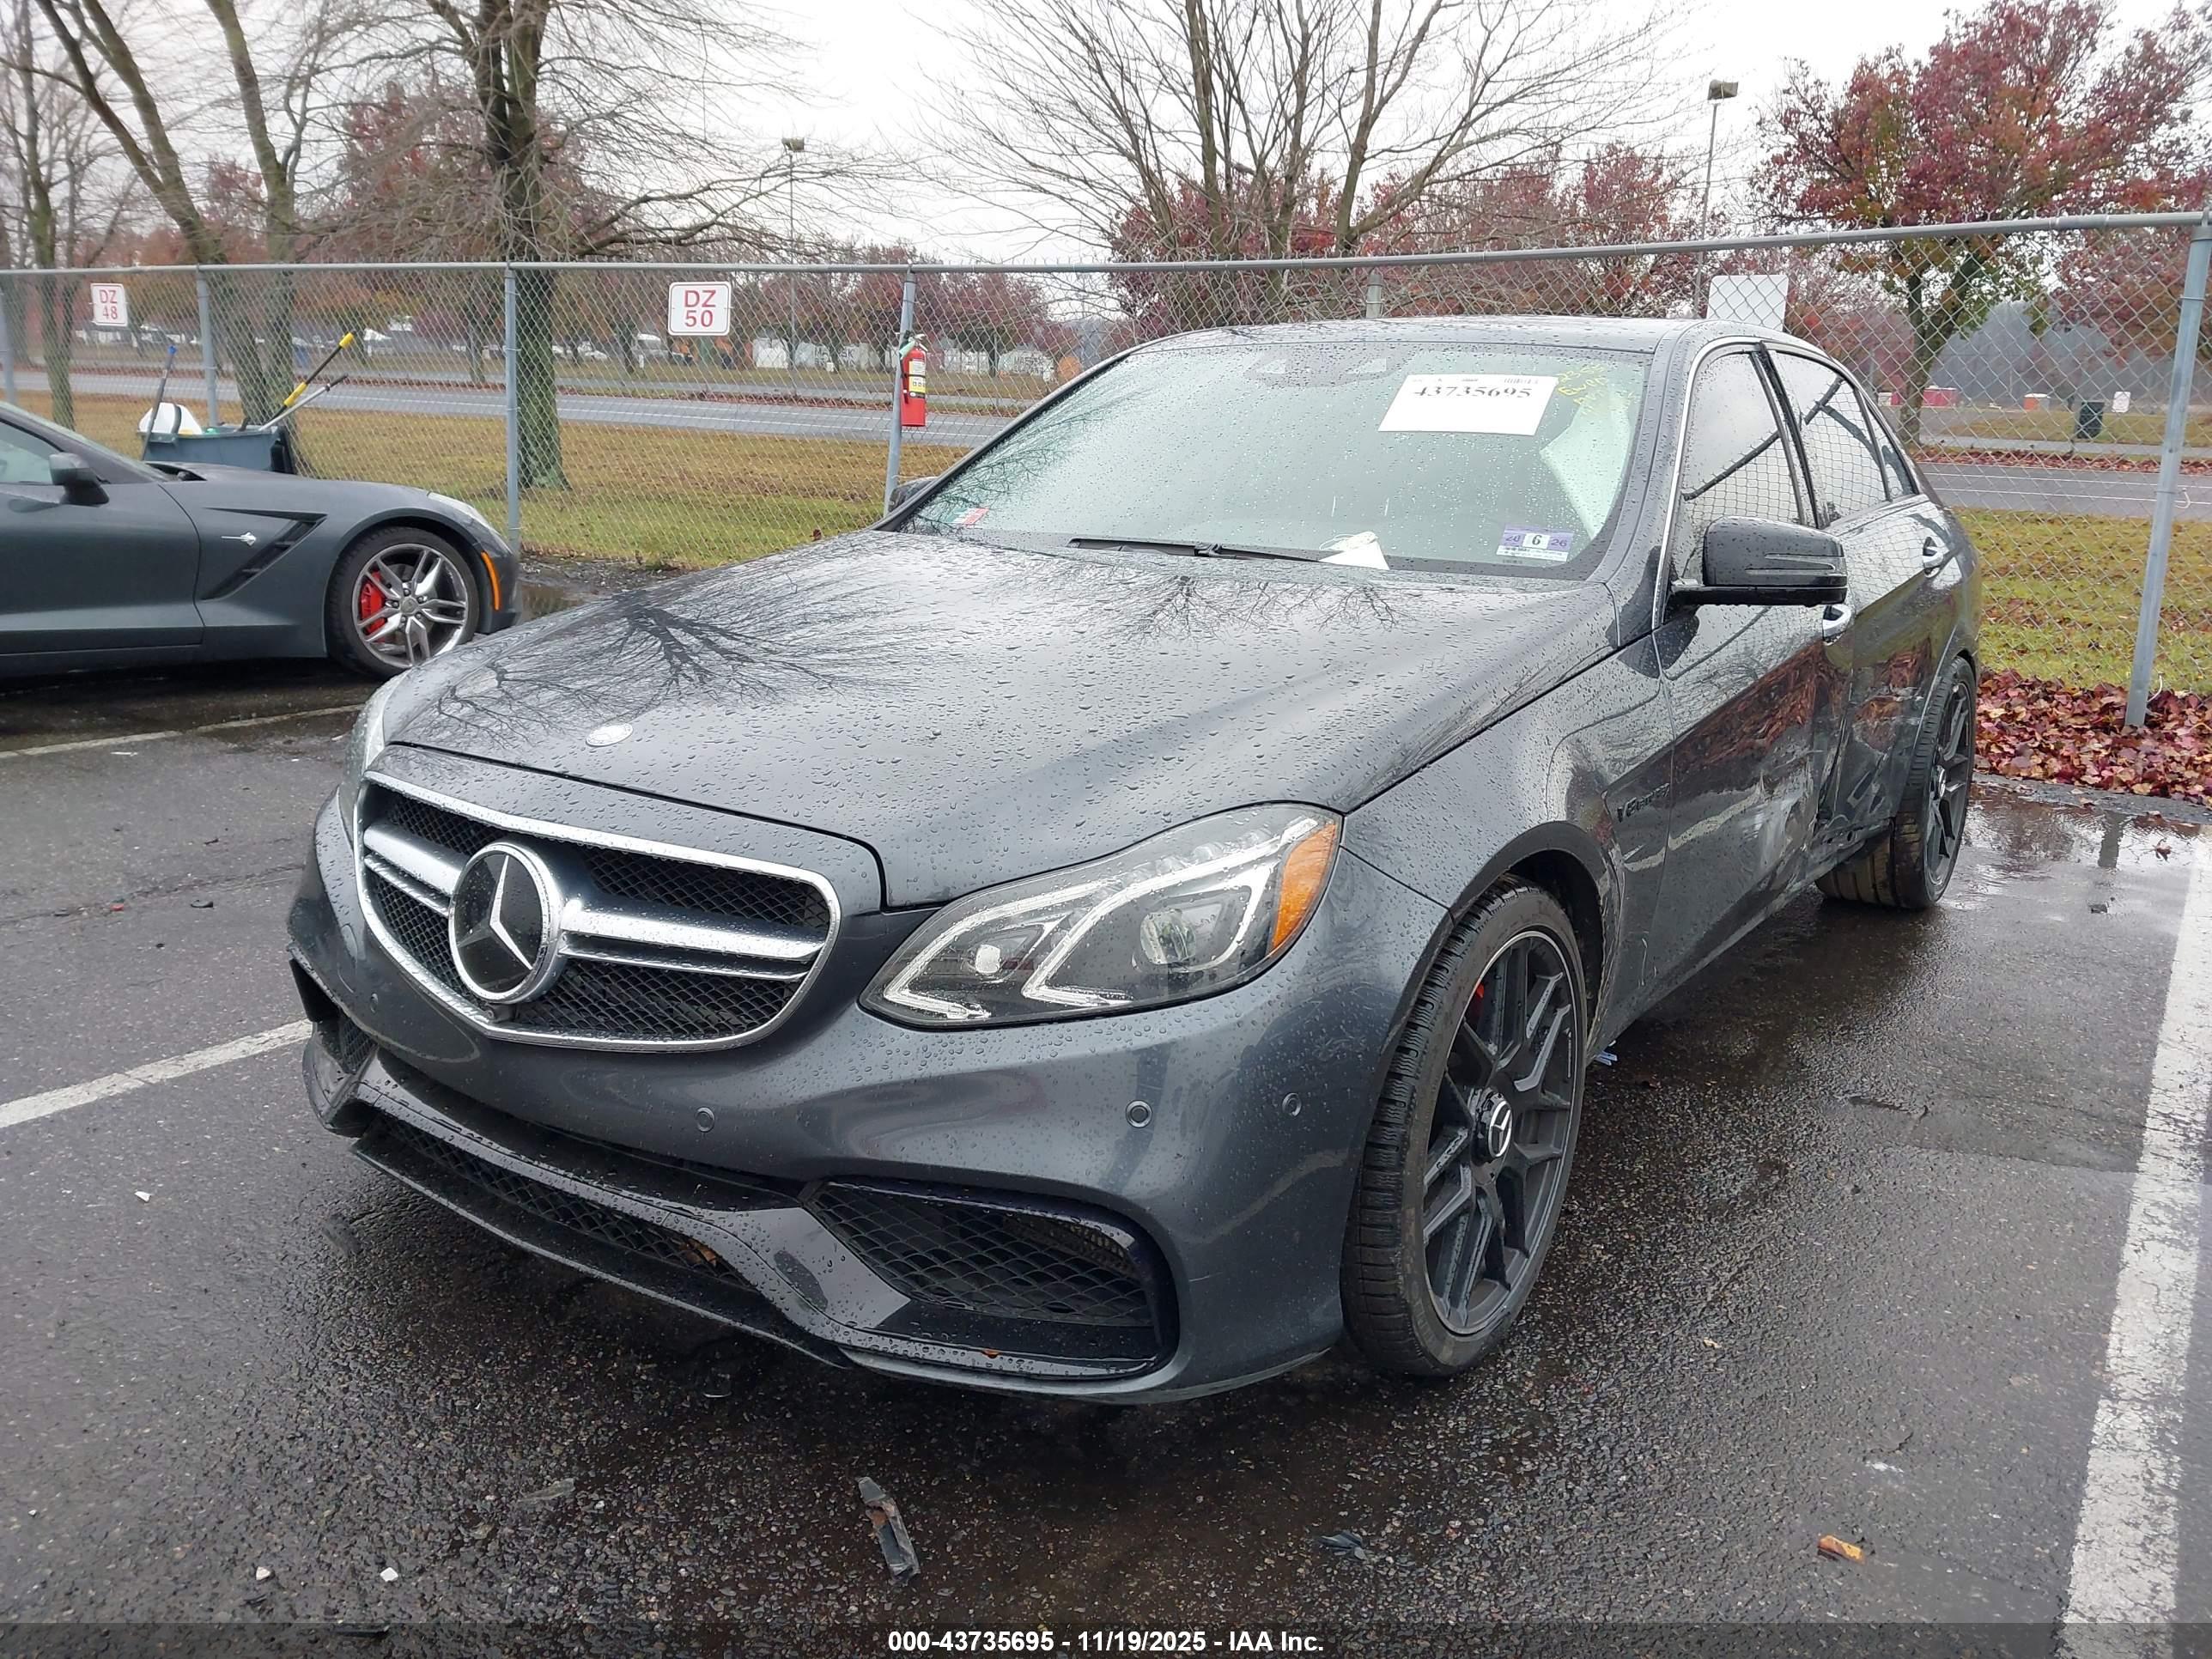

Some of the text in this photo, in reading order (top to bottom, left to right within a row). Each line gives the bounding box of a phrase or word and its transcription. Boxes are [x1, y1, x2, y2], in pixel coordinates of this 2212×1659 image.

[99, 289, 118, 303] DZ
[684, 289, 717, 307] DZ
[102, 306, 118, 319] 48
[684, 310, 714, 327] 50
[1413, 386, 1533, 398] 43735695
[1531, 534, 1542, 546] 6
[1551, 538, 1567, 547] 26
